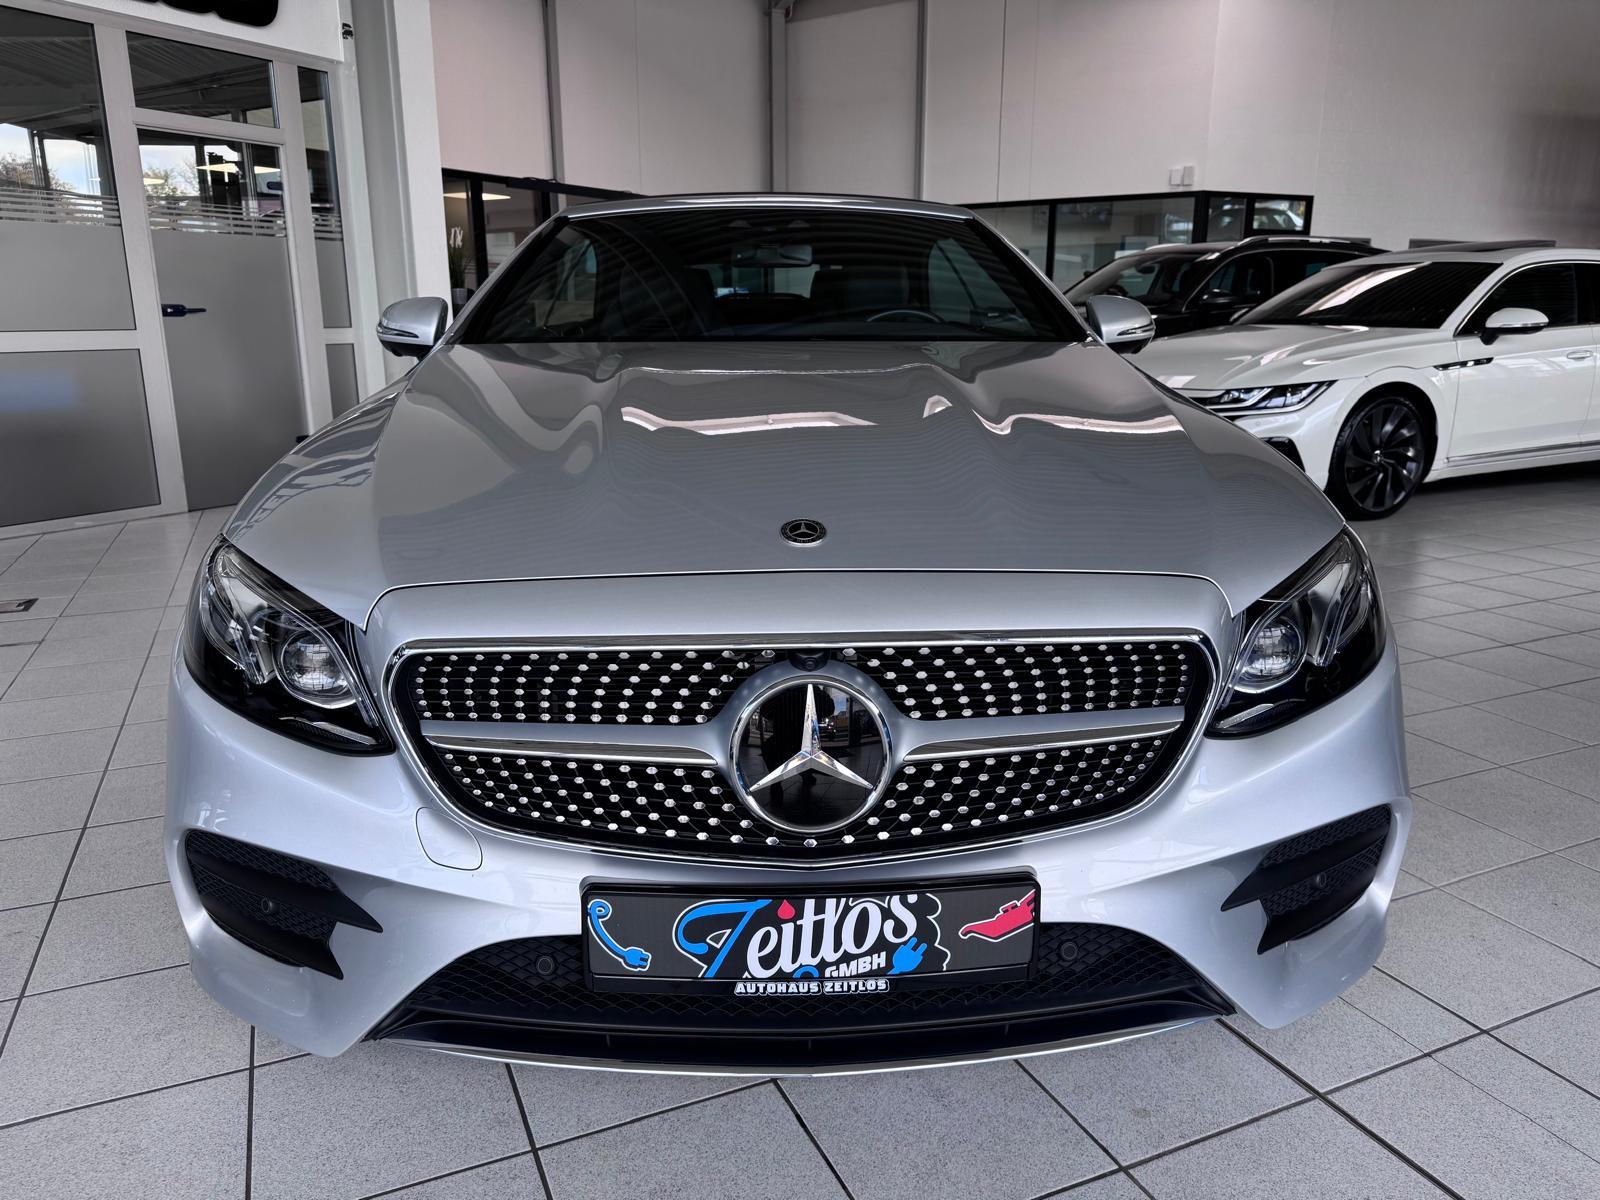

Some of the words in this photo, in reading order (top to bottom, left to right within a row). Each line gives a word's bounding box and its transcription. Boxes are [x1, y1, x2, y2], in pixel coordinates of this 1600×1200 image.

[824, 951, 887, 978] GMBH
[734, 981, 821, 995] AUTOHAUS
[823, 979, 889, 994] ZEITLOS
